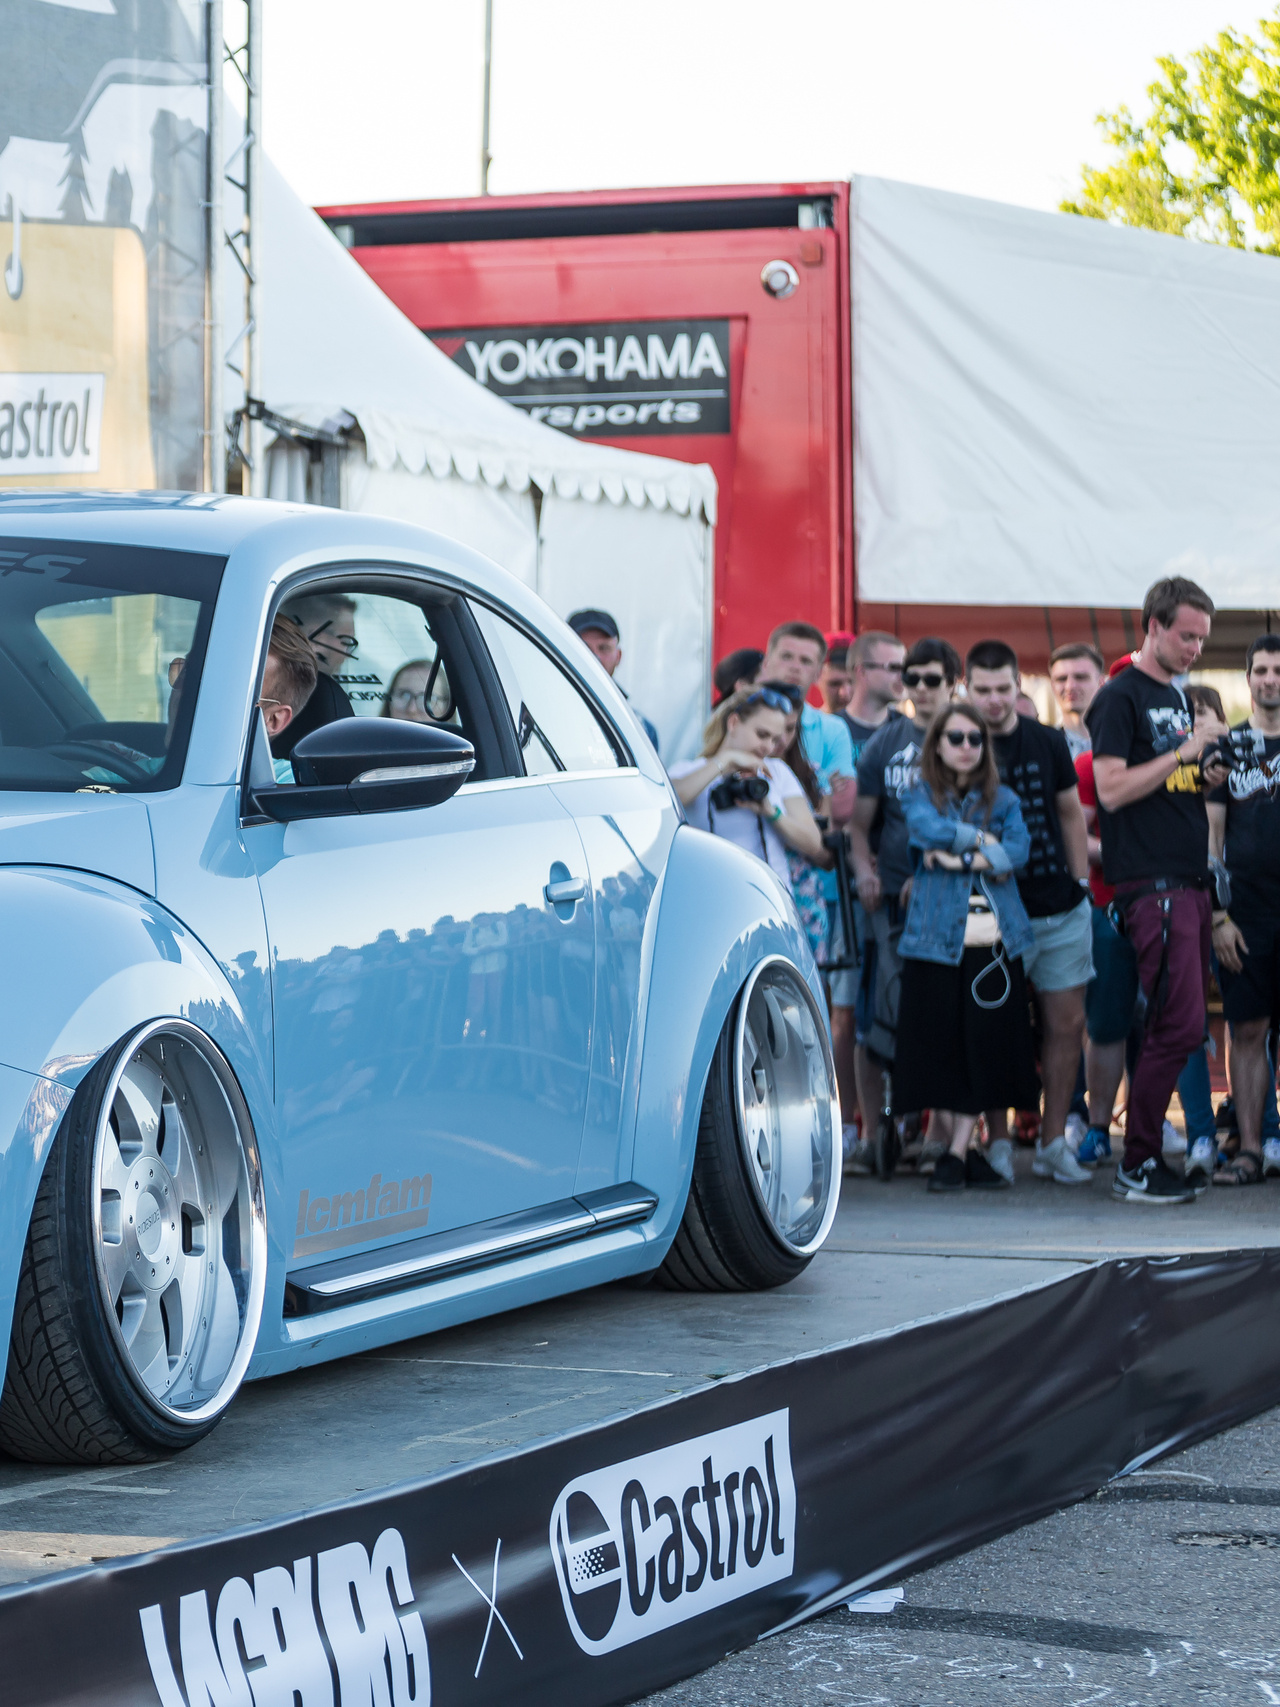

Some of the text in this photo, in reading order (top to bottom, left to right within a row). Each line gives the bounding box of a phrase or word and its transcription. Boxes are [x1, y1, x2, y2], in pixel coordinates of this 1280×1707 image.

[465, 332, 727, 385] YOKOHAMA
[517, 399, 702, 431] rsports
[296, 1173, 432, 1236] lcmfam
[621, 1434, 785, 1617] Castrol
